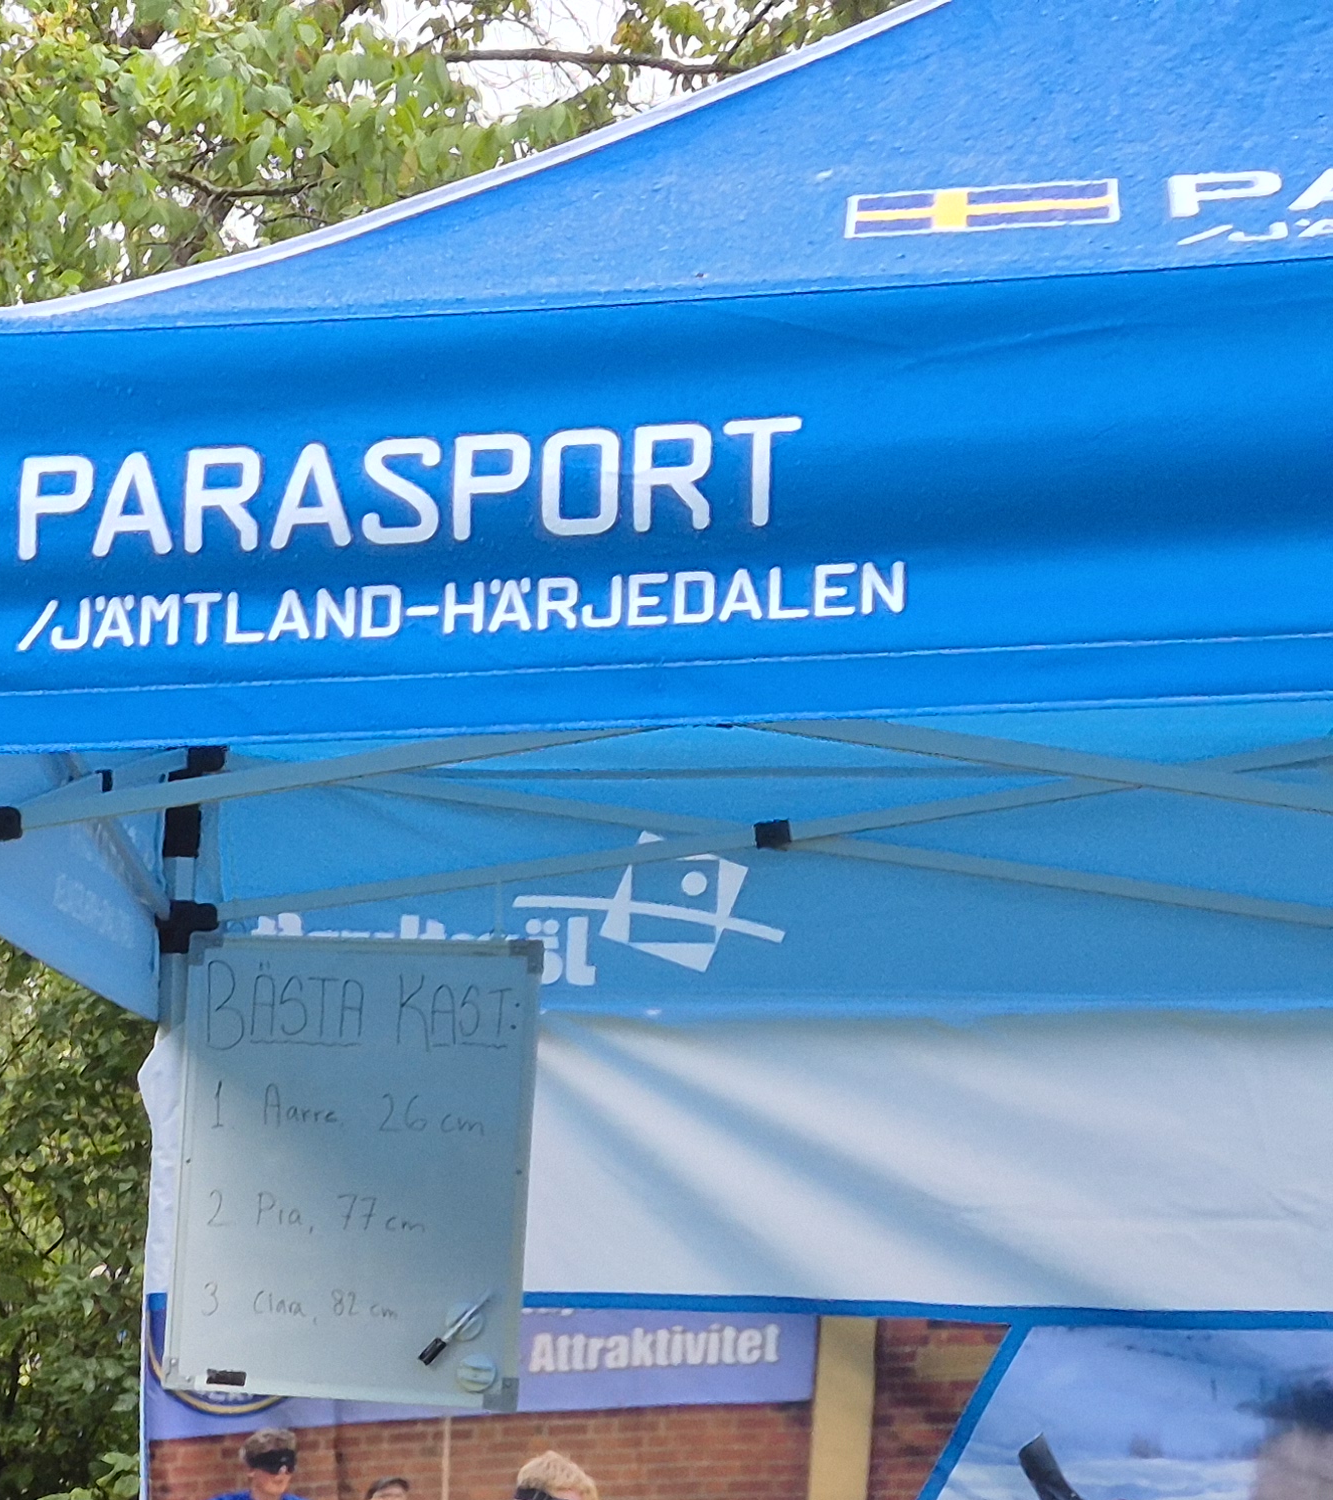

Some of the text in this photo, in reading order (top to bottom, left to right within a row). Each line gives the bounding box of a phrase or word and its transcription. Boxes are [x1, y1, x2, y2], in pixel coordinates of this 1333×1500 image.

[19, 415, 803, 561] PARASPORT
[16, 560, 906, 651] /JÄMTLAND-HÄRJEDALEN
[206, 959, 521, 1051] BÄSTA KAST:
[378, 1093, 427, 1132] 26
[440, 1113, 484, 1136] cm
[337, 1194, 378, 1231] 77
[201, 1281, 220, 1317] 3
[331, 1289, 360, 1317] 82
[369, 1303, 399, 1321] cm
[528, 1323, 780, 1373] Attraktivitet
